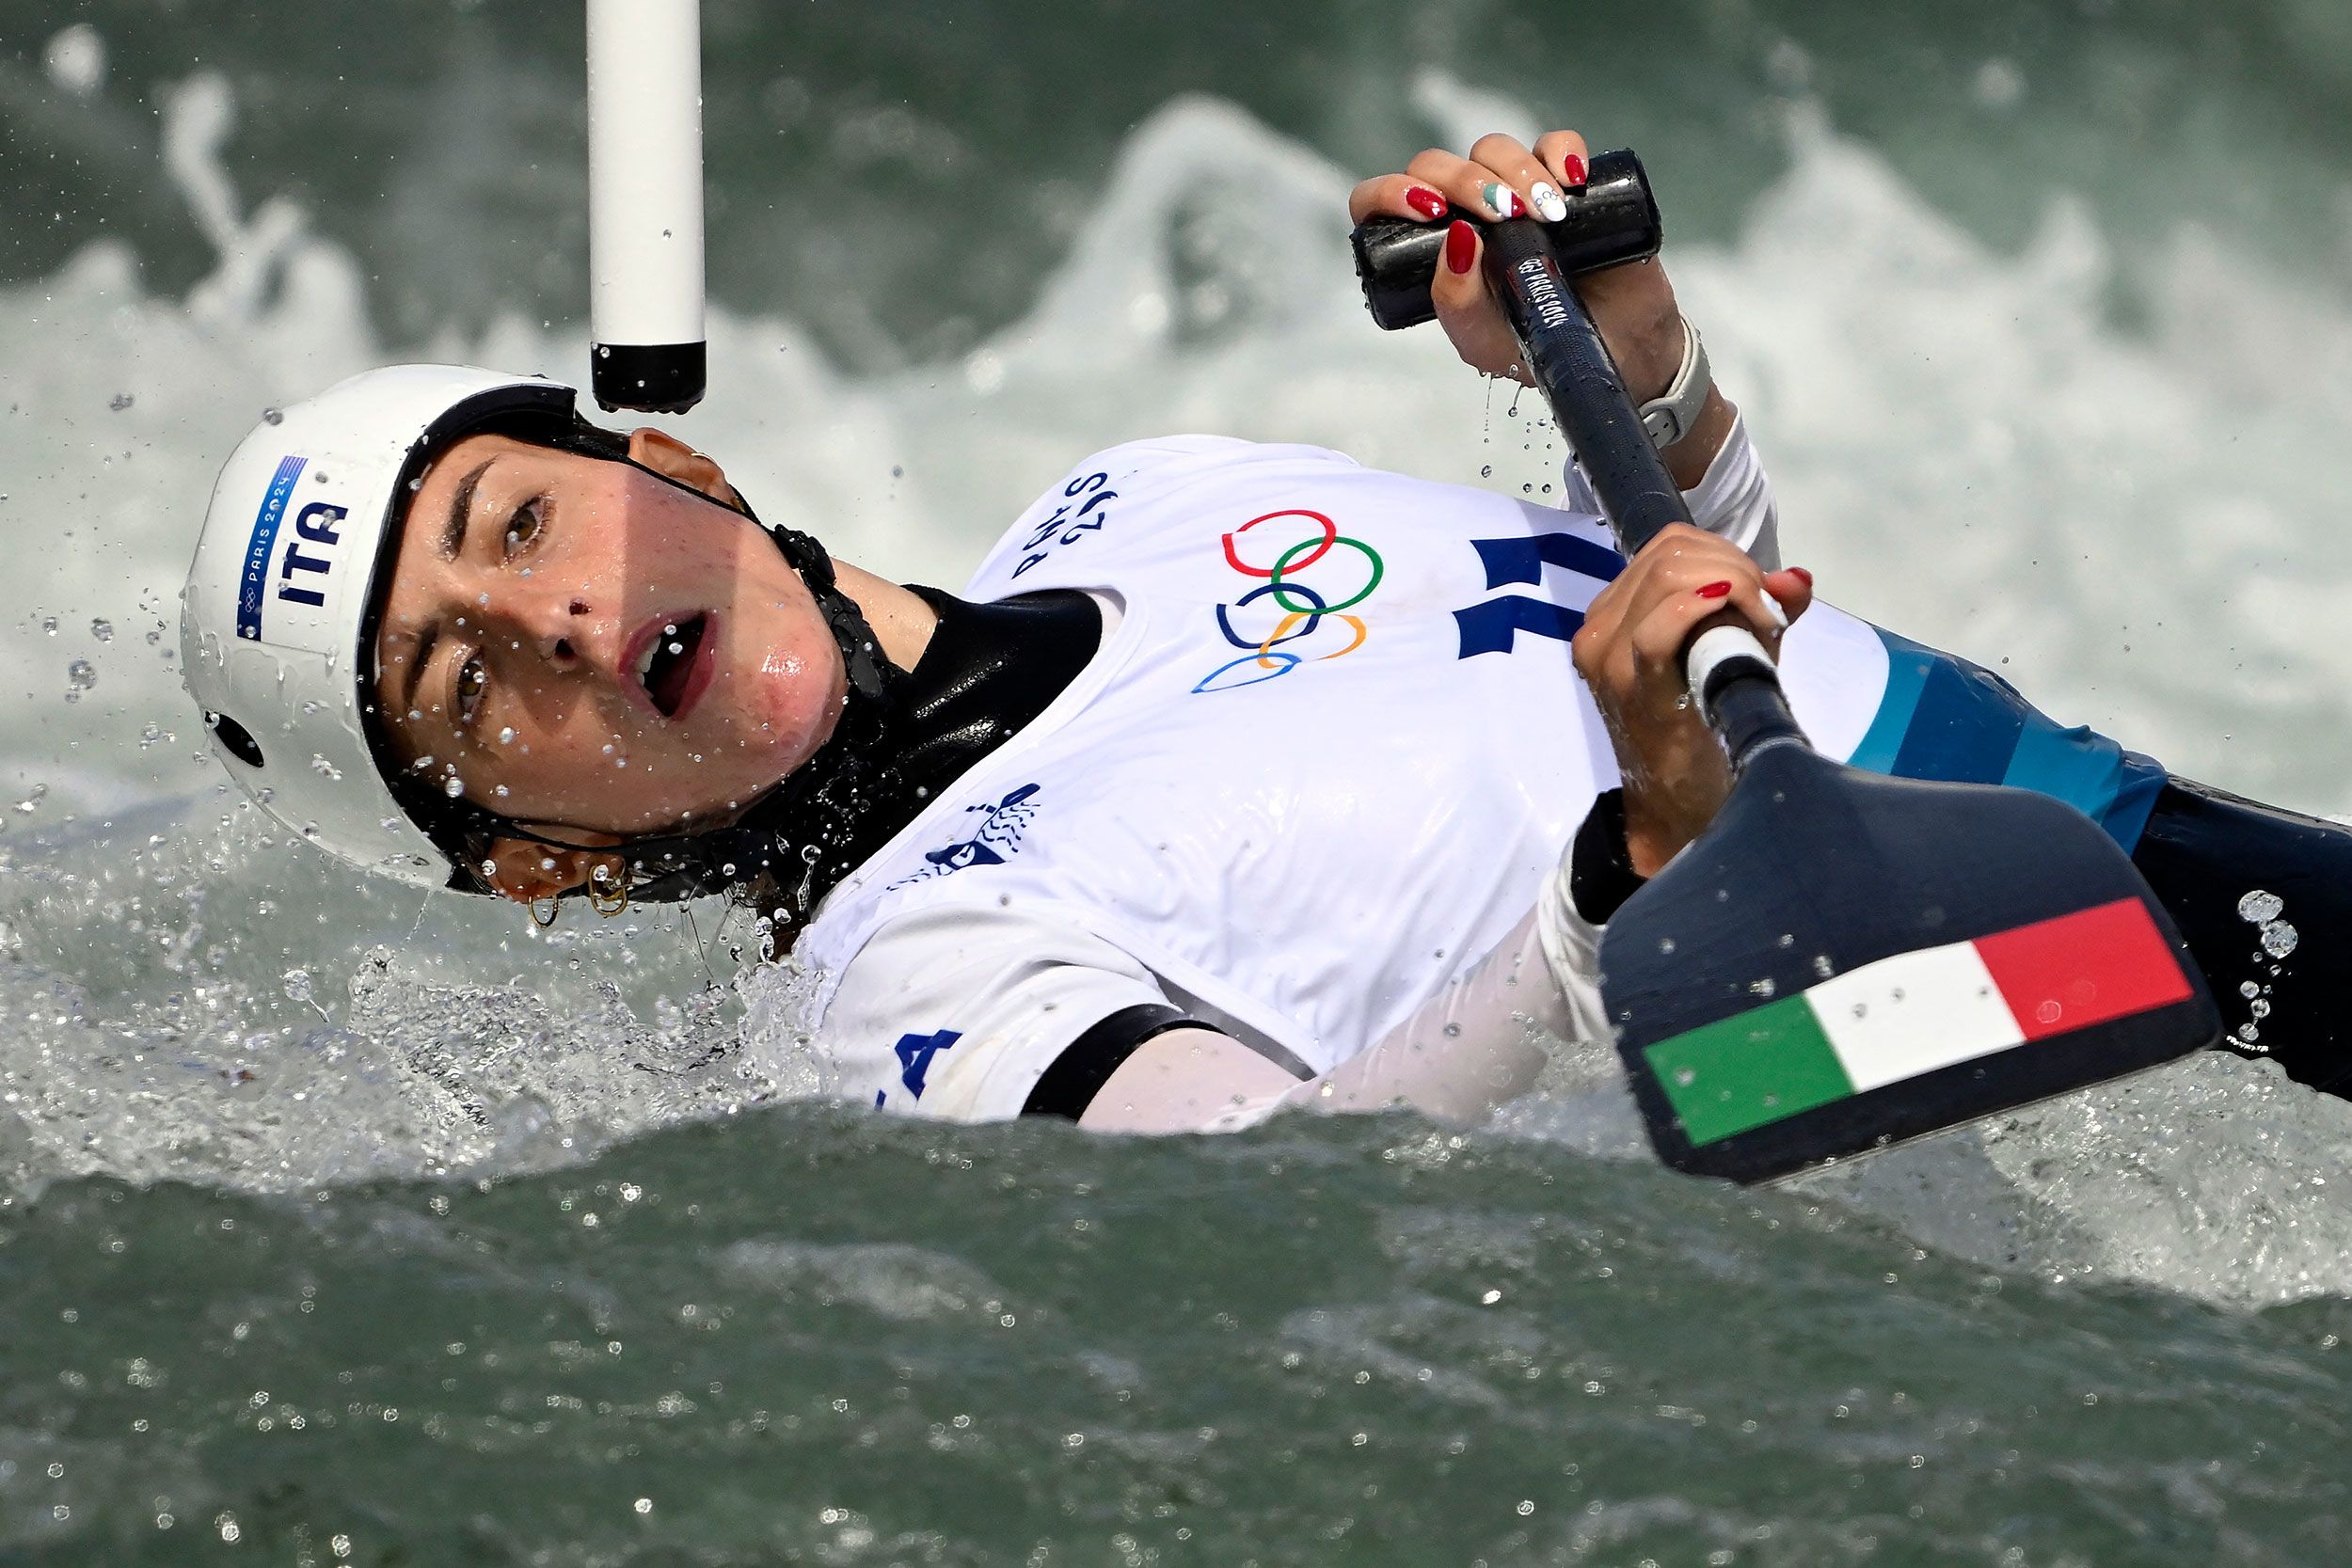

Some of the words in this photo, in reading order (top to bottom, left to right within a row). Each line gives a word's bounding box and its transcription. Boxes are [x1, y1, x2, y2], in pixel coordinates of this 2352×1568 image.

[1525, 273, 1559, 304] PARIS
[1538, 300, 1569, 328] 2024
[248, 529, 270, 581] PARIS
[278, 501, 349, 607] ITA
